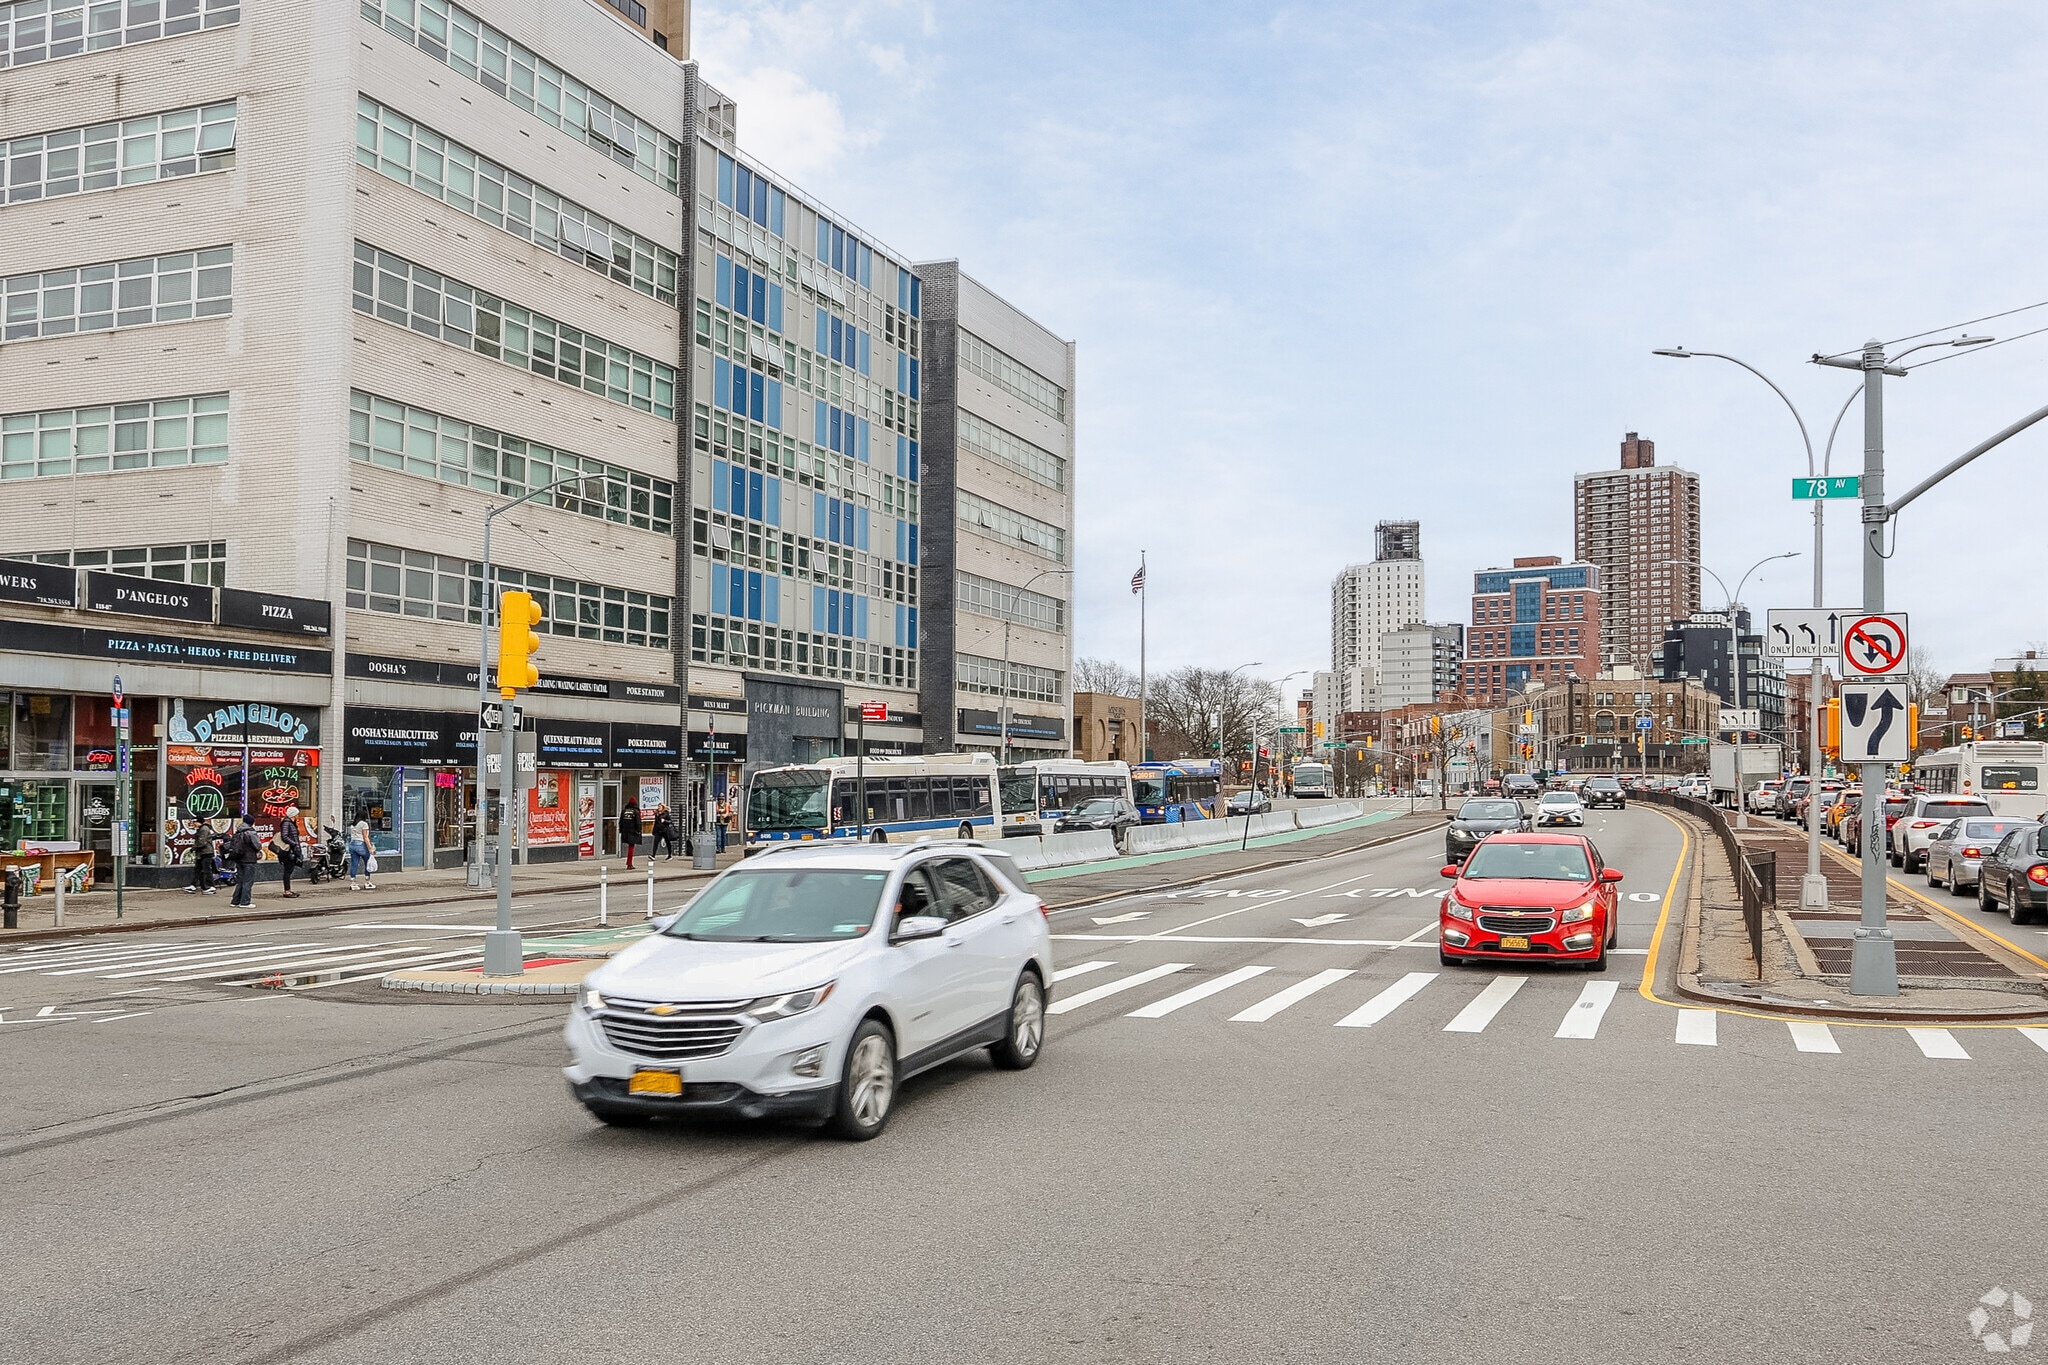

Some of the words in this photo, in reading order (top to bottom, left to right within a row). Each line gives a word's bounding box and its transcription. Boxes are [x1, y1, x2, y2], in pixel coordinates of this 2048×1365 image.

[1806, 480, 1828, 497] 78
[1835, 479, 1847, 488] AV
[117, 588, 189, 608] D'ANGELO'S
[261, 604, 294, 620] PIZZA
[108, 639, 139, 651] PIZZA
[147, 642, 180, 655] PASTA
[187, 646, 221, 658] HEROS
[228, 649, 251, 660] FREE
[252, 652, 298, 665] DELIVERY
[1770, 646, 1791, 654] ONLY
[1796, 646, 1817, 654] ONLY
[1822, 646, 1840, 654] ONL
[368, 661, 407, 675] OOSHA'S
[626, 686, 642, 696] POKE
[641, 688, 665, 698] STATION
[703, 700, 716, 708] MINI
[716, 702, 730, 710] MART
[754, 701, 790, 715] PICKMAN
[795, 705, 830, 718] BUILDING
[194, 702, 309, 743] D'ANGELO'S
[211, 733, 244, 743] PIZZERIA
[252, 735, 295, 744] RESTAURANT
[352, 727, 388, 738] OOSHA'S
[388, 728, 439, 741] HAIRCUTTERS
[543, 734, 564, 746] QUEENS
[564, 735, 583, 745] BEAUTY
[583, 736, 603, 746] PARLOR
[627, 738, 644, 748] POKE
[644, 739, 667, 748] STATION
[716, 742, 730, 750] MART
[86, 752, 114, 763] OPEN
[168, 754, 186, 763] Order
[186, 754, 206, 763] Ahead
[250, 750, 267, 758] Order
[186, 767, 223, 786] D'ANGELO
[263, 766, 299, 782] PASTA
[640, 777, 663, 785] AVAILABLE
[190, 793, 220, 812] PIZZA
[170, 808, 176, 816] B
[262, 802, 295, 818] HERO
[1319, 888, 1452, 899] ONLY
